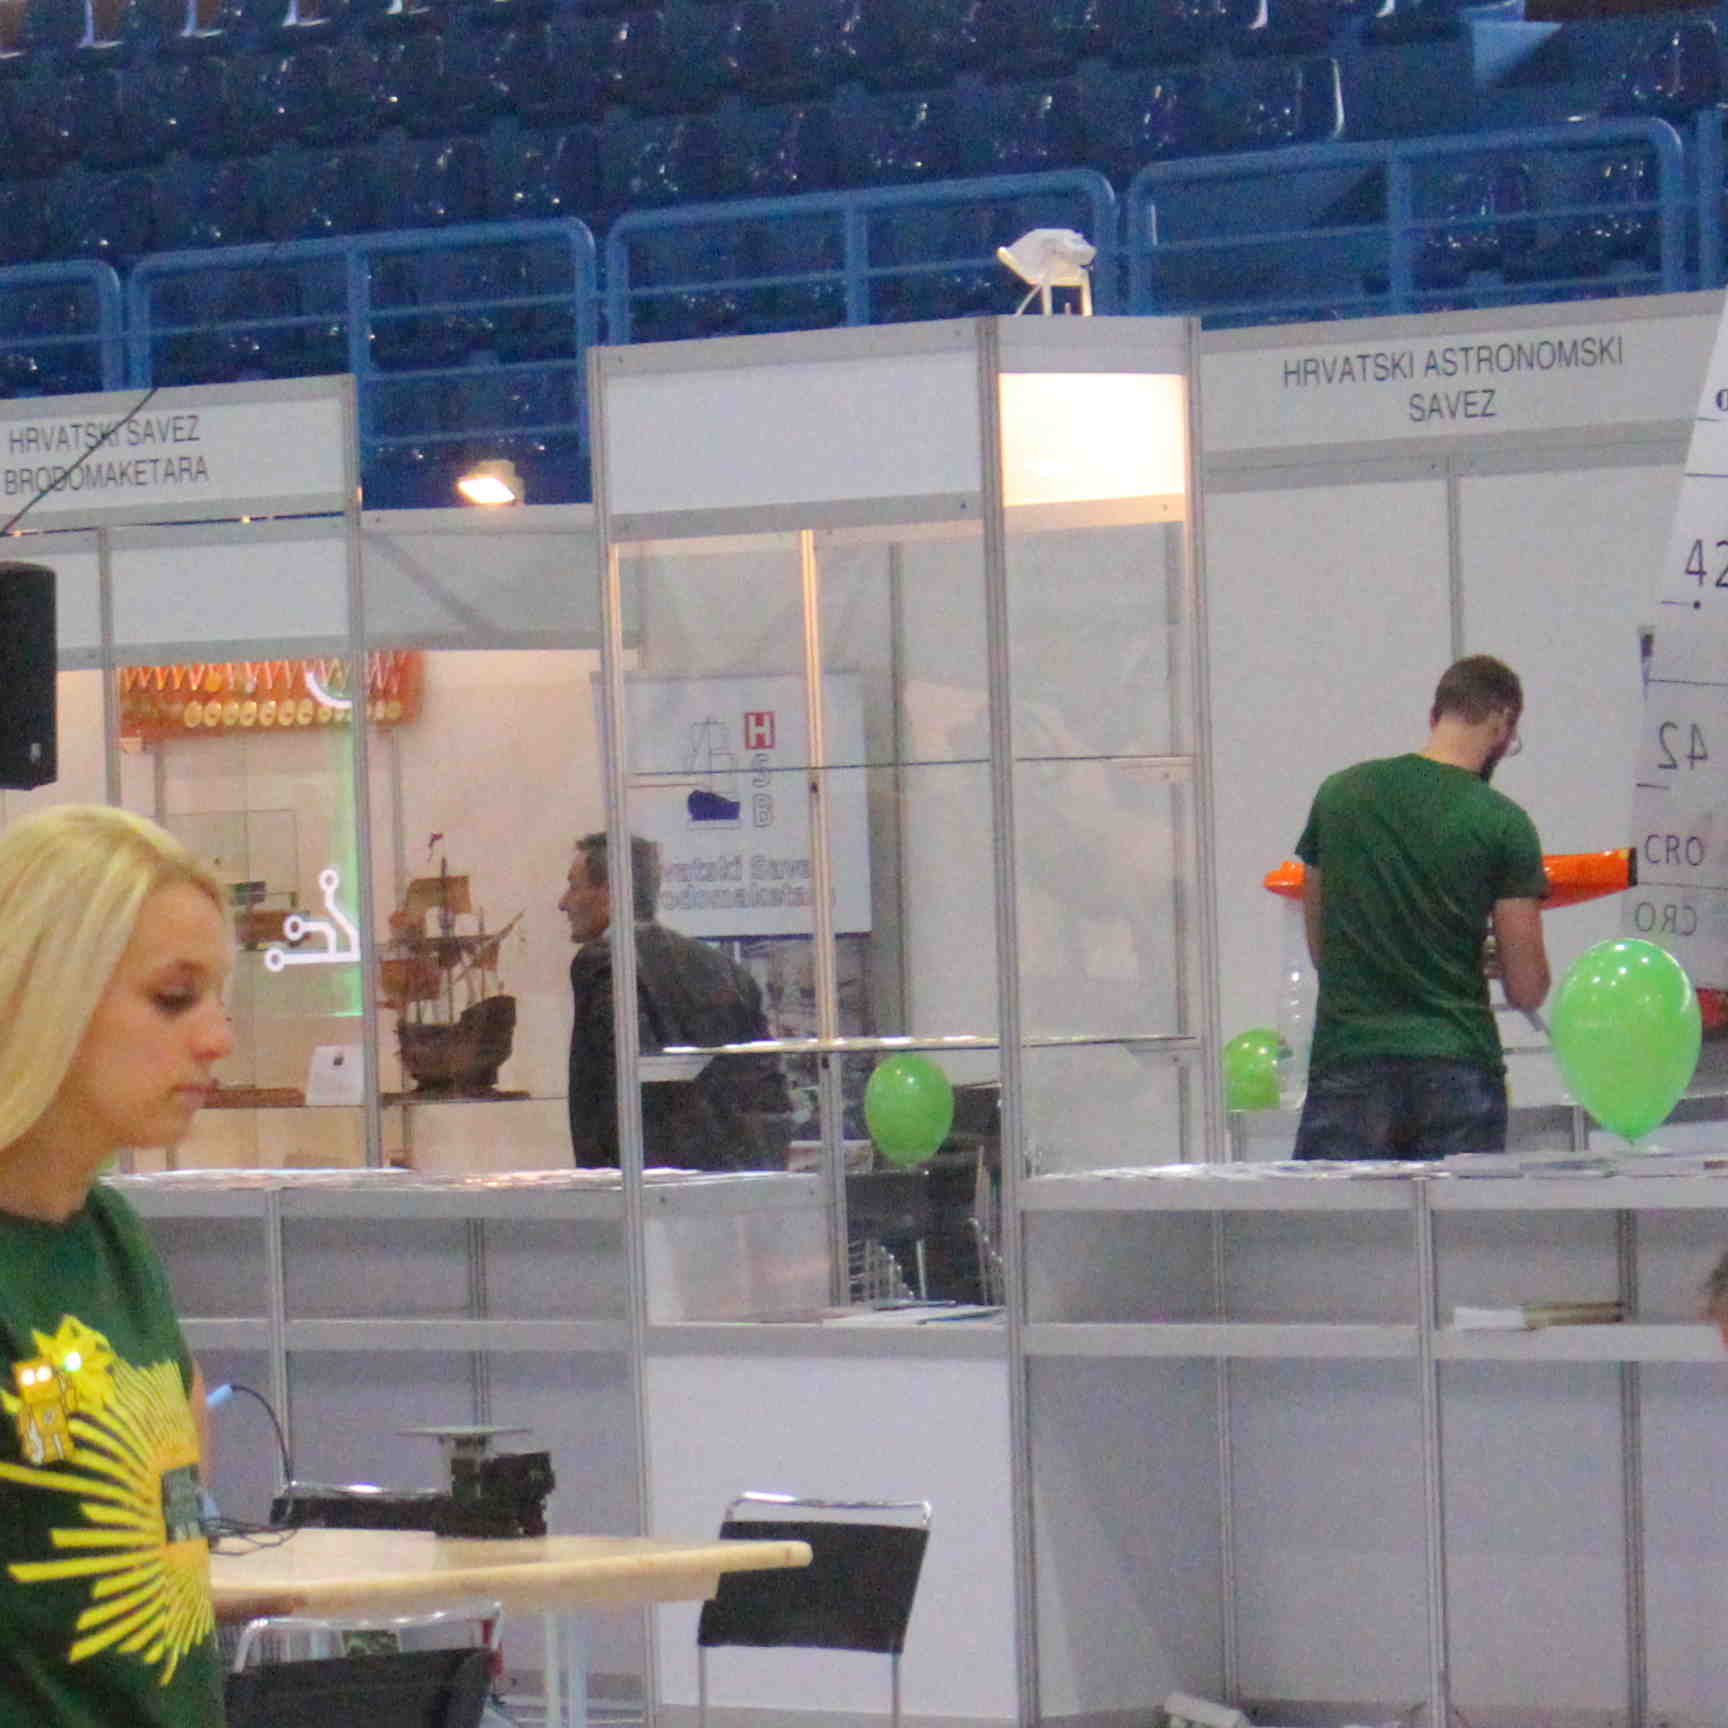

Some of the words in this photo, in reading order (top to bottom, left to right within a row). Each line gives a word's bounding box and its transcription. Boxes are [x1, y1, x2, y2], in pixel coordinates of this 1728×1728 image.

[1284, 353, 1414, 387] HRVATSKI
[1424, 336, 1624, 378] ASTRONOMSKI
[1408, 388, 1497, 423] SAVEZ
[9, 421, 121, 454] HRVATSKI
[125, 414, 201, 447] SAVEZ
[3, 456, 210, 497] BRODOMAKETARA
[1645, 834, 1705, 866] CRO
